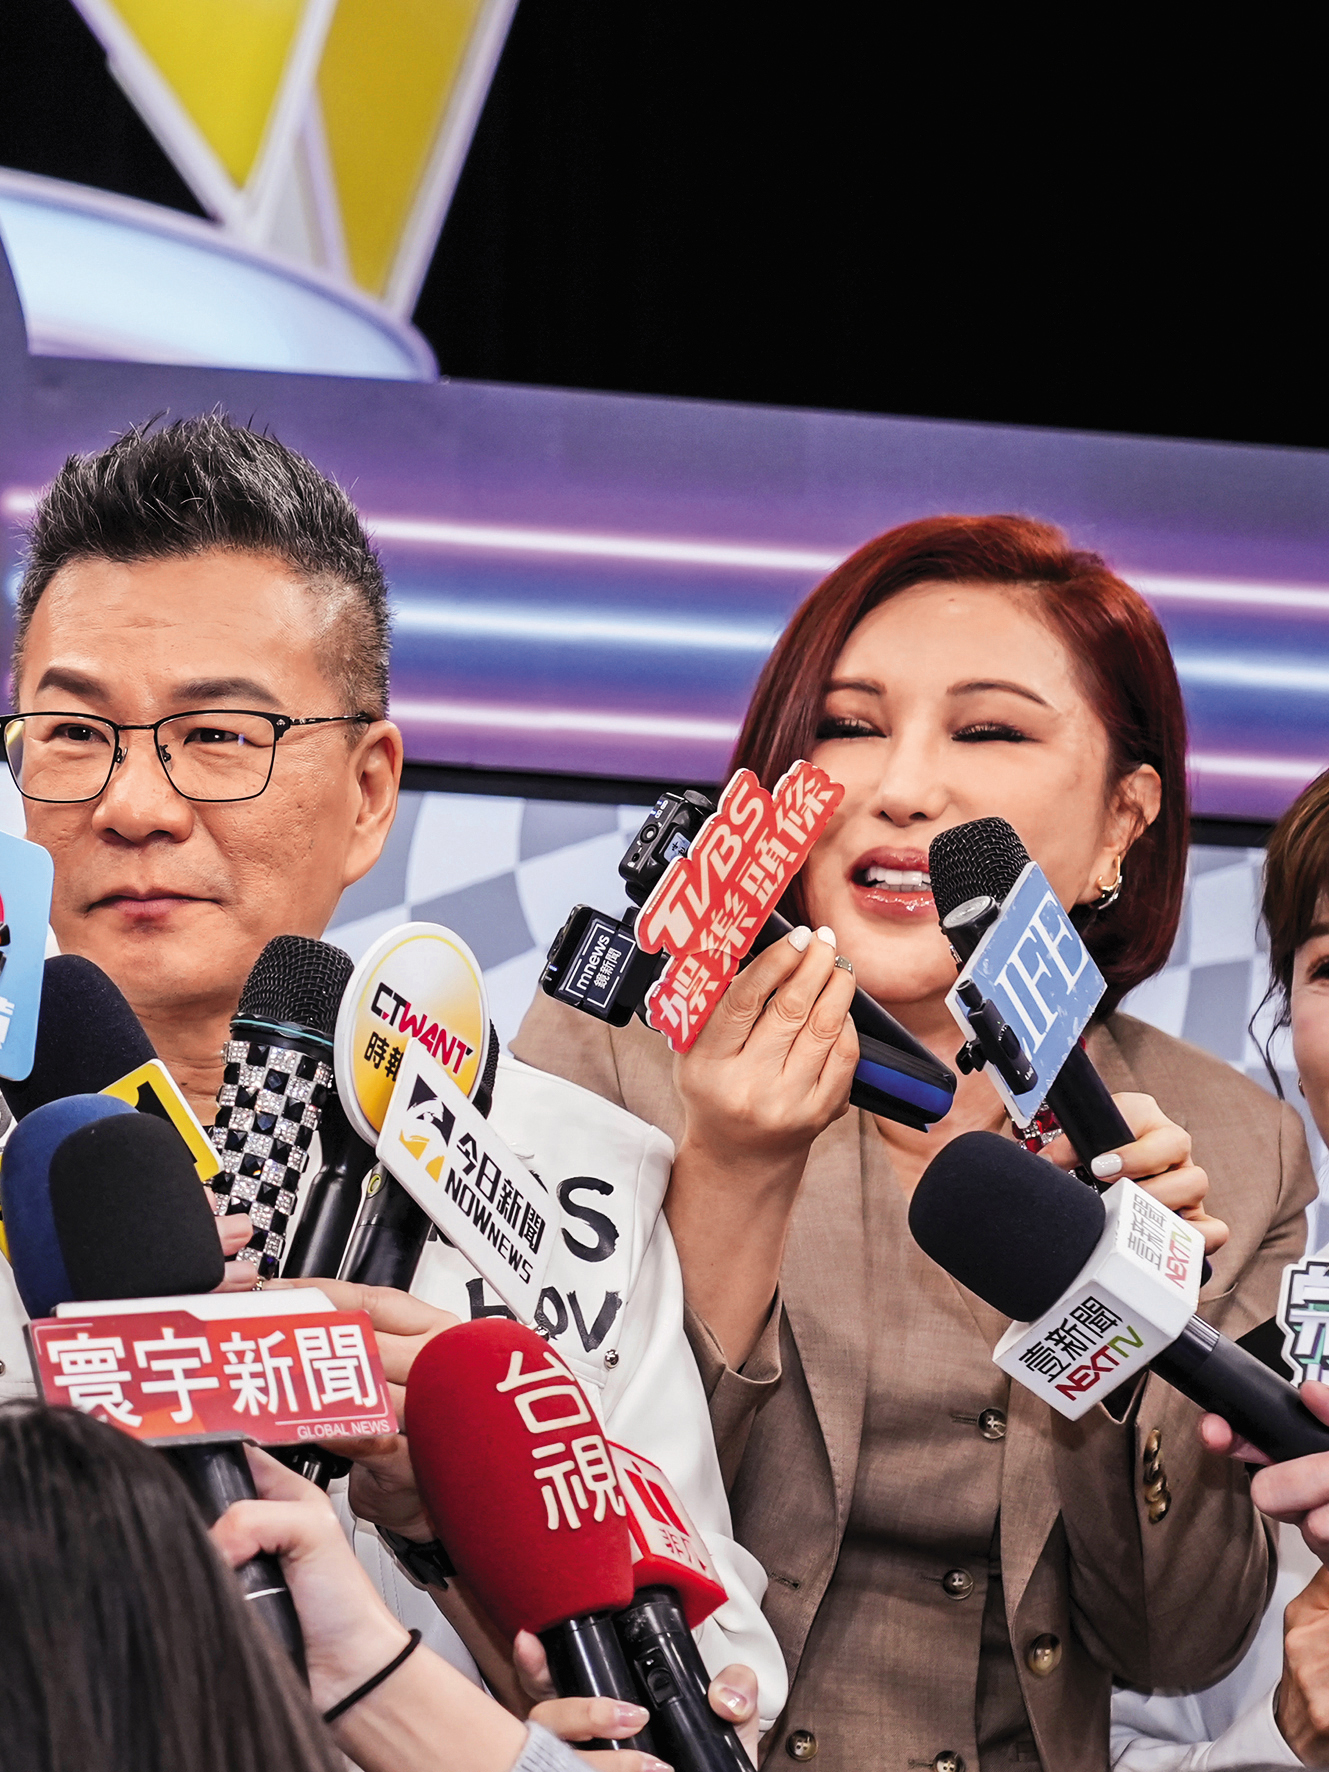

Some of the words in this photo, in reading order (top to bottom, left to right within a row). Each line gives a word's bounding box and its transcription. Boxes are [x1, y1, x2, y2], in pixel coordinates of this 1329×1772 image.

[648, 781, 765, 949] TVBS
[660, 772, 834, 1044] 娛樂頭條
[576, 934, 610, 991] mnews
[593, 947, 622, 990] 鏡新聞
[994, 890, 1090, 1062] IFE
[370, 981, 474, 1075] CTWANT
[444, 1167, 534, 1285] NOWNEWS
[456, 1132, 547, 1255] 今日新聞
[46, 1324, 379, 1428] 寰宇新聞
[1018, 1295, 1124, 1384] 壹新聞
[297, 1423, 350, 1439] GLOBAL
[351, 1419, 391, 1436] NEWS
[496, 1350, 627, 1531] 台視
